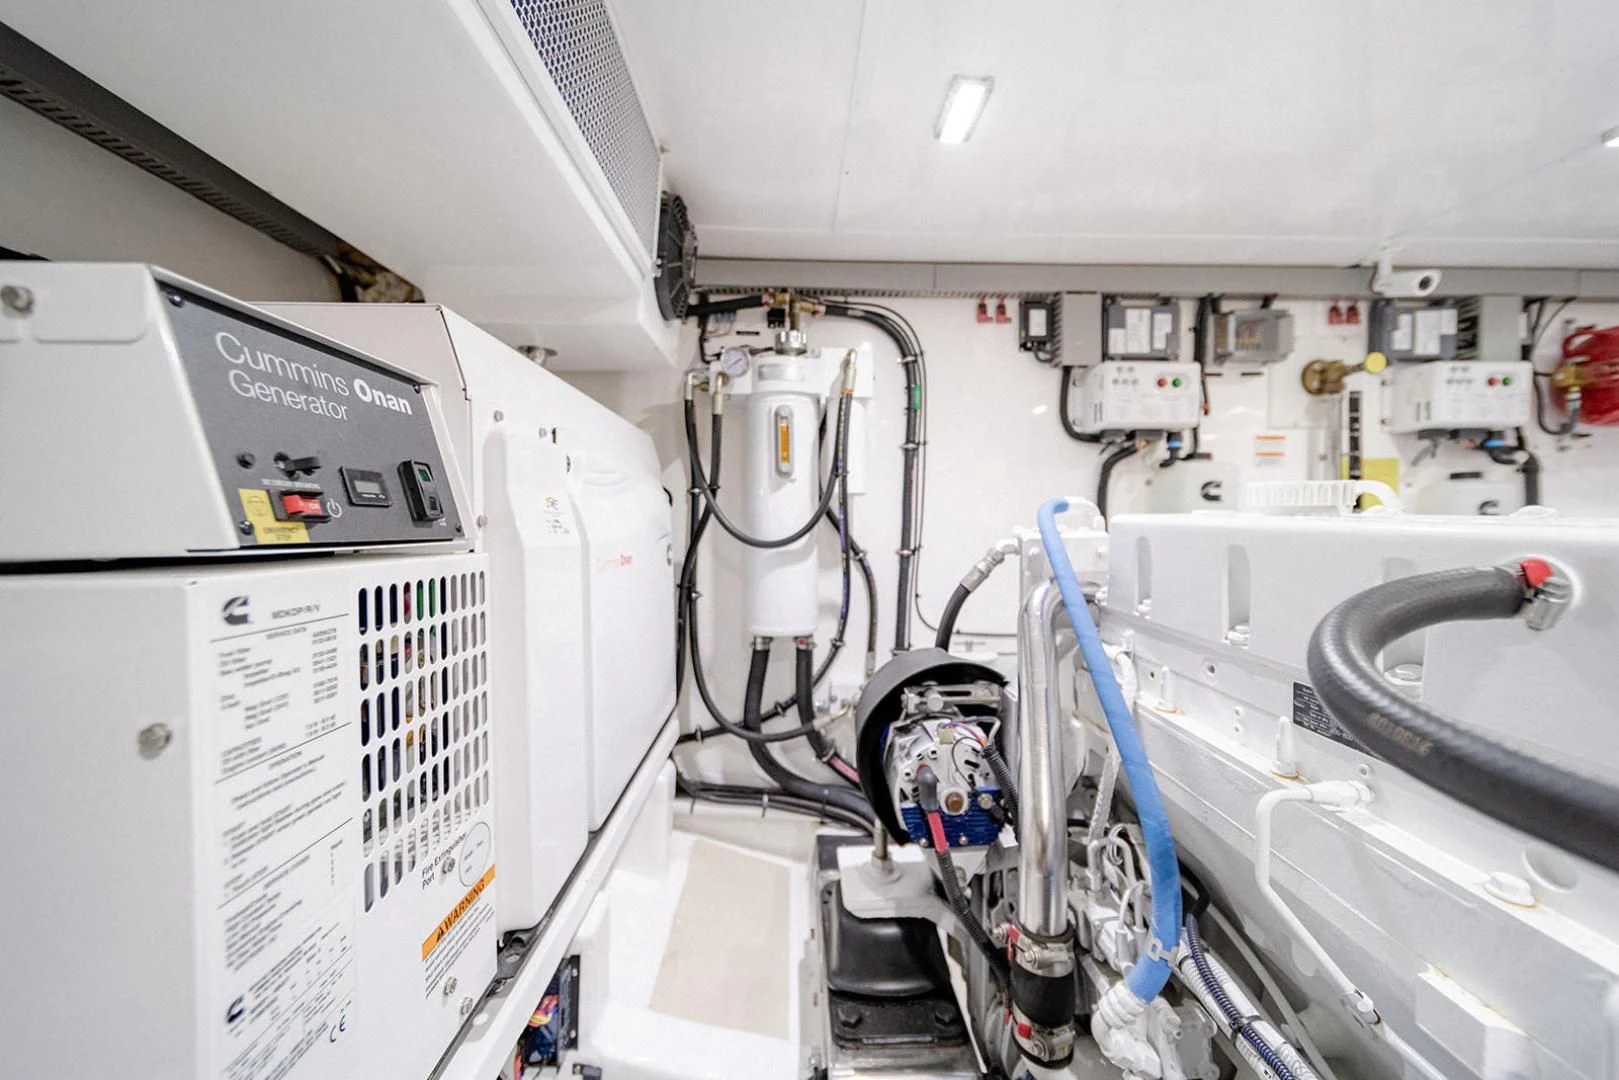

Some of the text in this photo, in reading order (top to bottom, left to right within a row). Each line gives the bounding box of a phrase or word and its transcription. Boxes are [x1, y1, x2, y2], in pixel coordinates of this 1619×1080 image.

[215, 332, 413, 415] Cummins Onan
[228, 369, 349, 421] Generator
[422, 863, 434, 879] Fire
[422, 872, 435, 891] Port
[443, 878, 486, 932] WARNING
